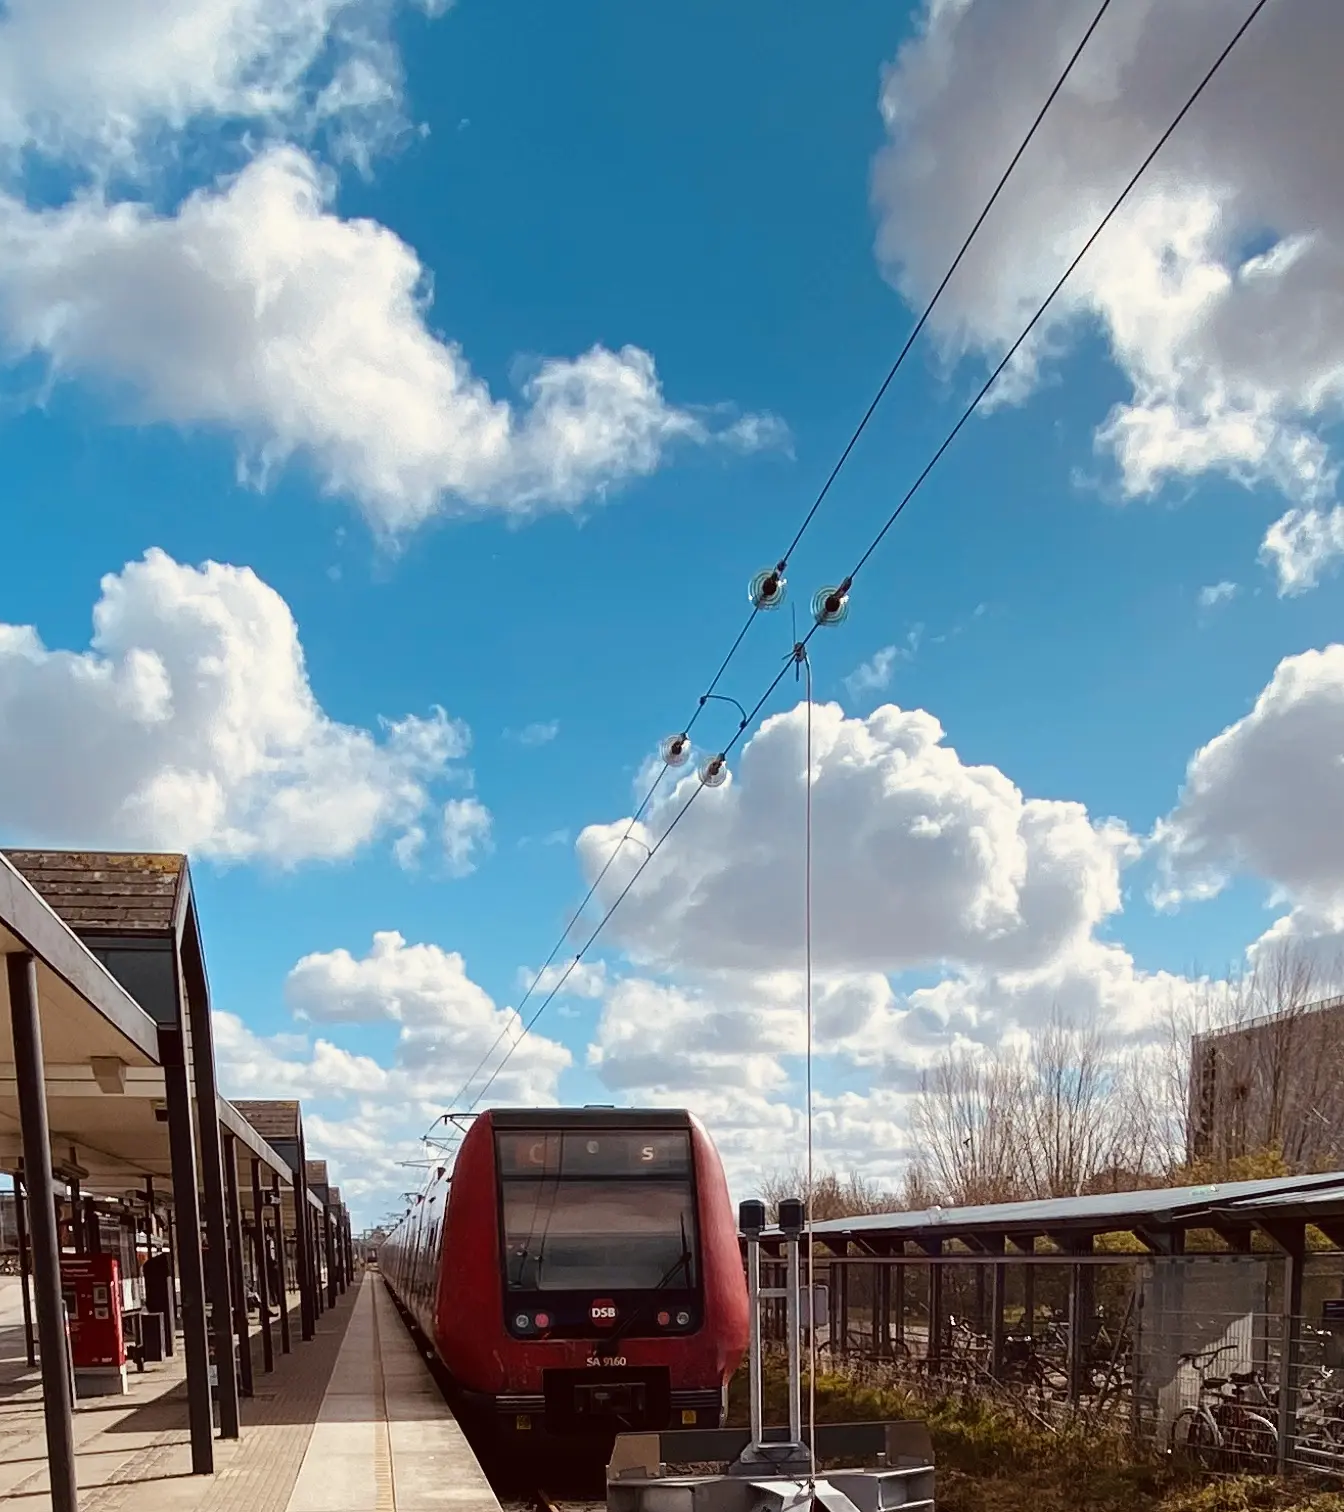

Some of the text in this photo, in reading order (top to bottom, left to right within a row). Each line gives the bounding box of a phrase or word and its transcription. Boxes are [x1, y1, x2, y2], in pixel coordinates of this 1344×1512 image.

[641, 1146, 654, 1161] S
[591, 1307, 616, 1318] DSB
[586, 1356, 627, 1367] SA 9160
